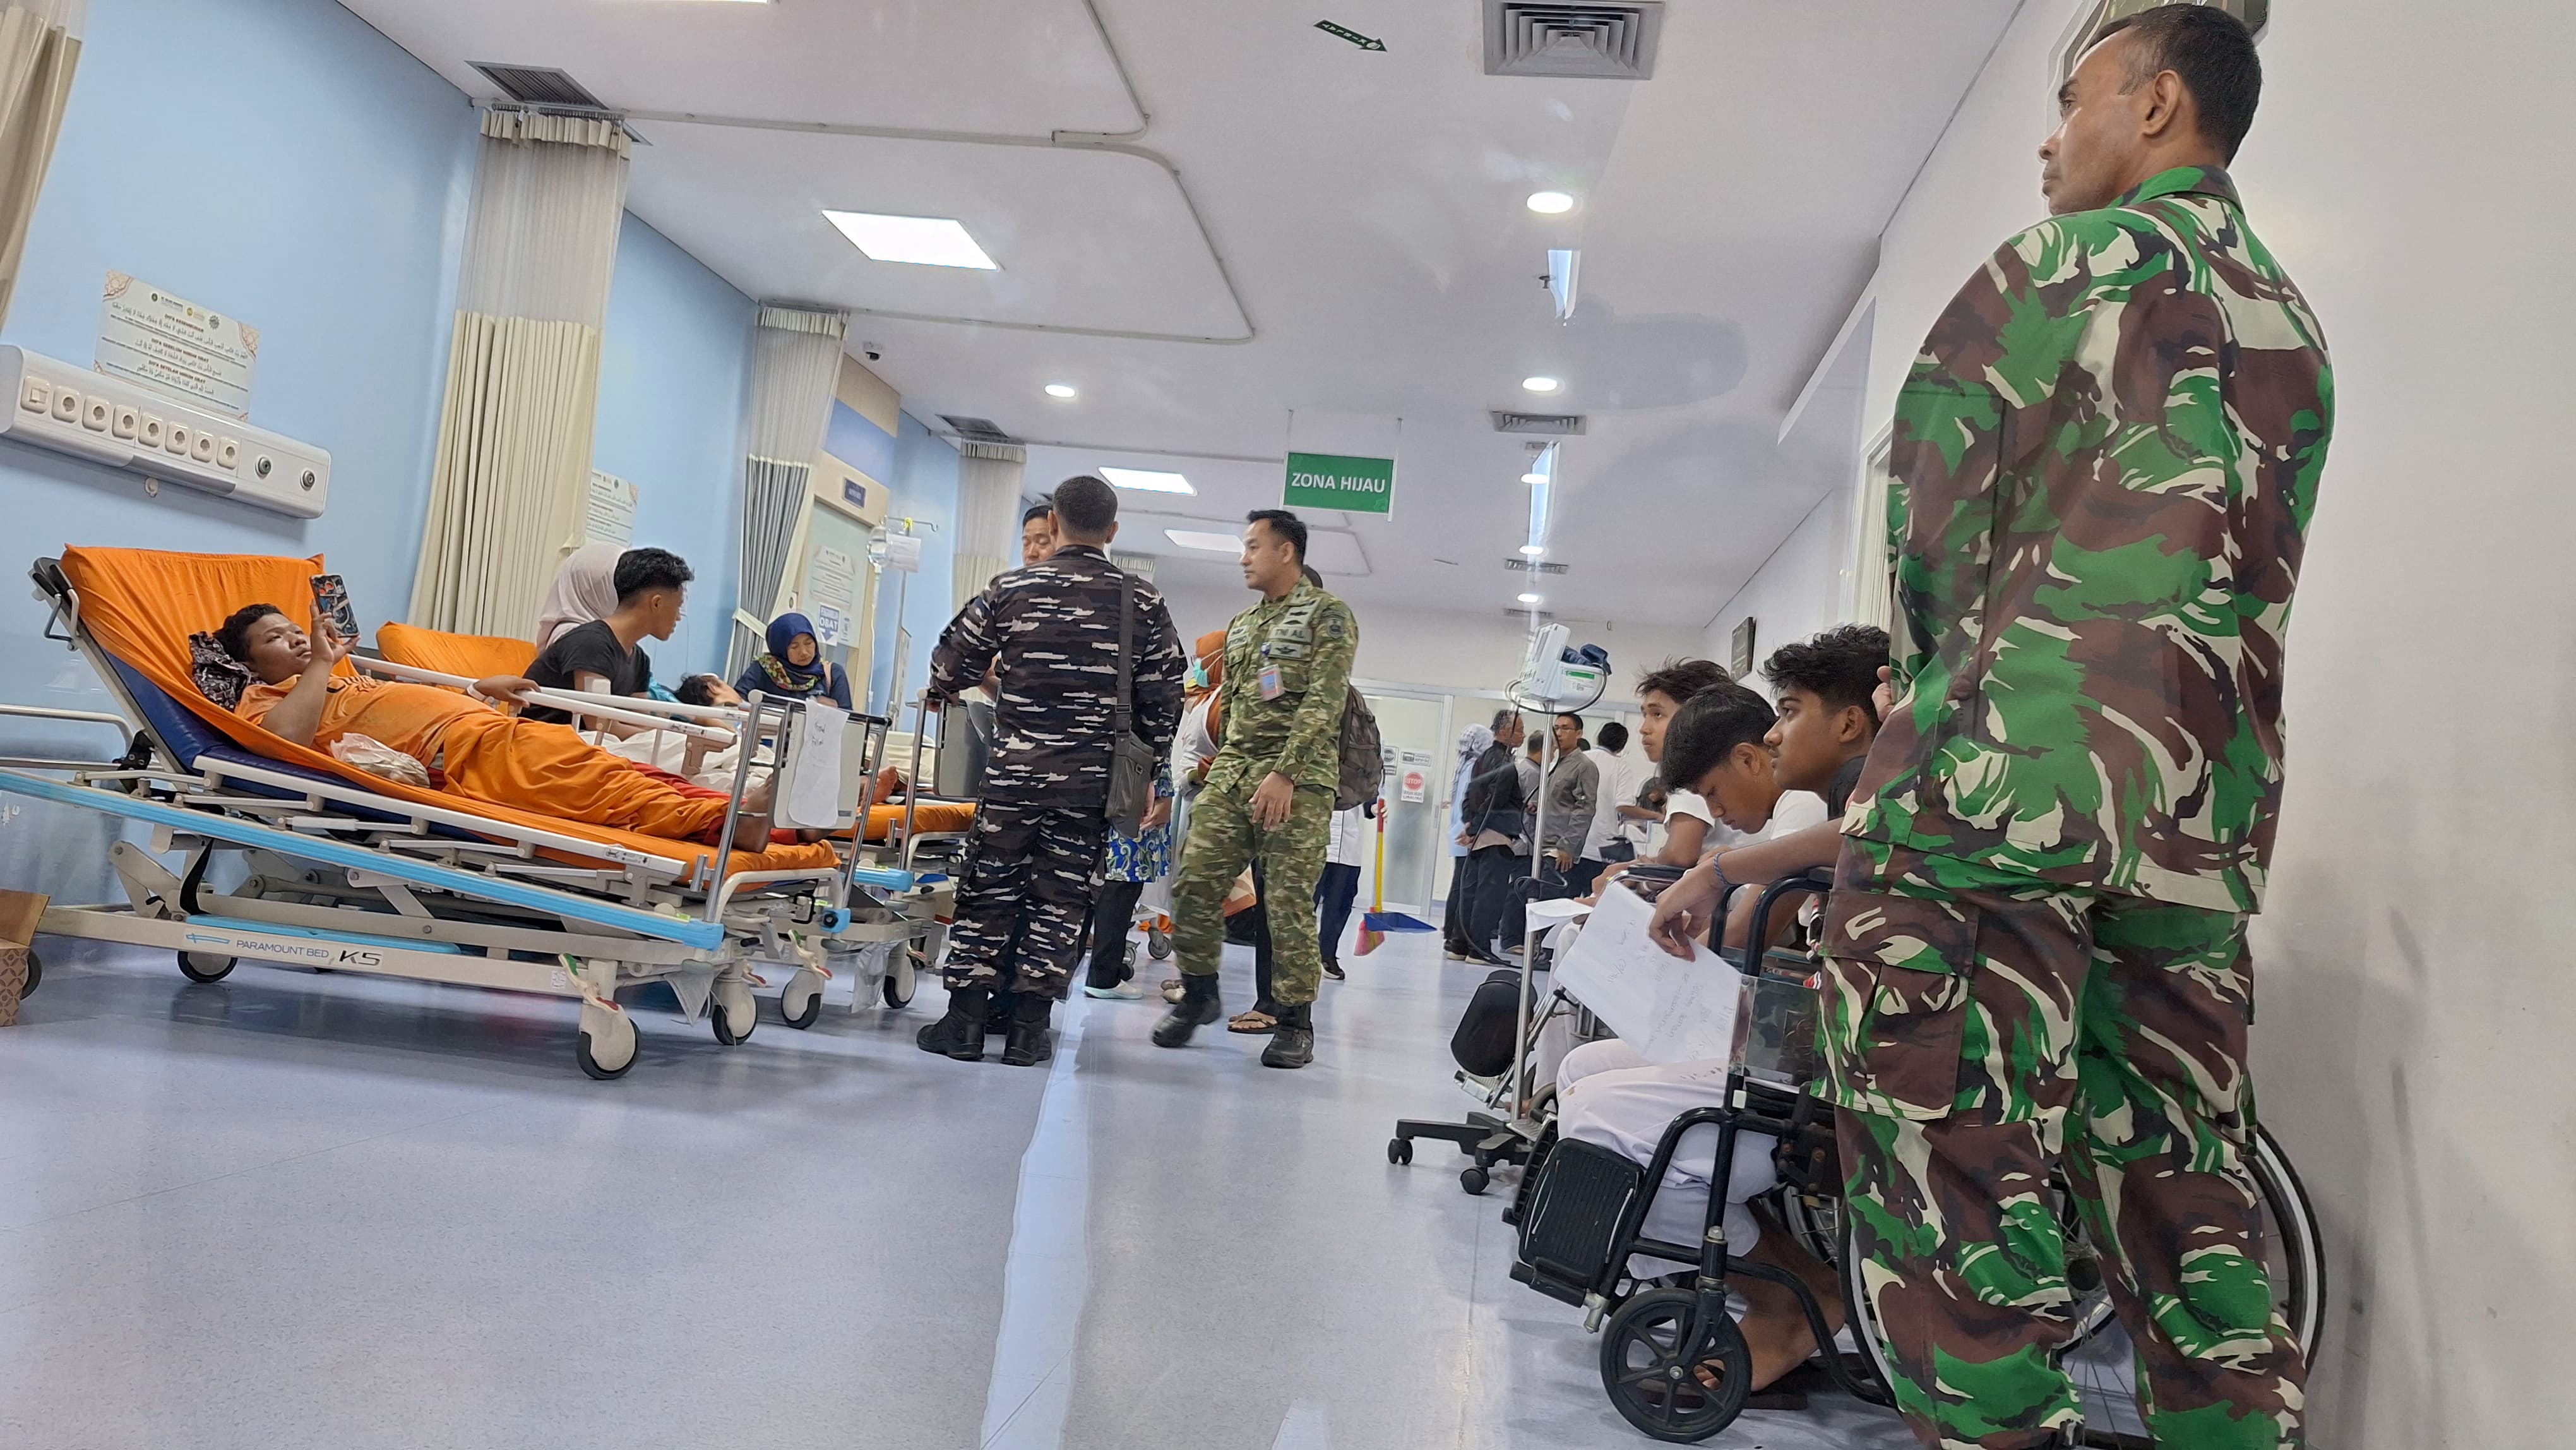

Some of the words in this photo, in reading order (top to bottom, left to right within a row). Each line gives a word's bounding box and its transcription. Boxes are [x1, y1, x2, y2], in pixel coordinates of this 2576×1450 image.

[1321, 23, 1368, 44] KIBLAT
[1291, 472, 1336, 489] ZONA
[1340, 476, 1386, 493] HIJAU
[820, 618, 838, 631] OBAT
[237, 940, 305, 956] PARAMOUNT
[306, 949, 329, 958] BED
[339, 950, 382, 966] K5
